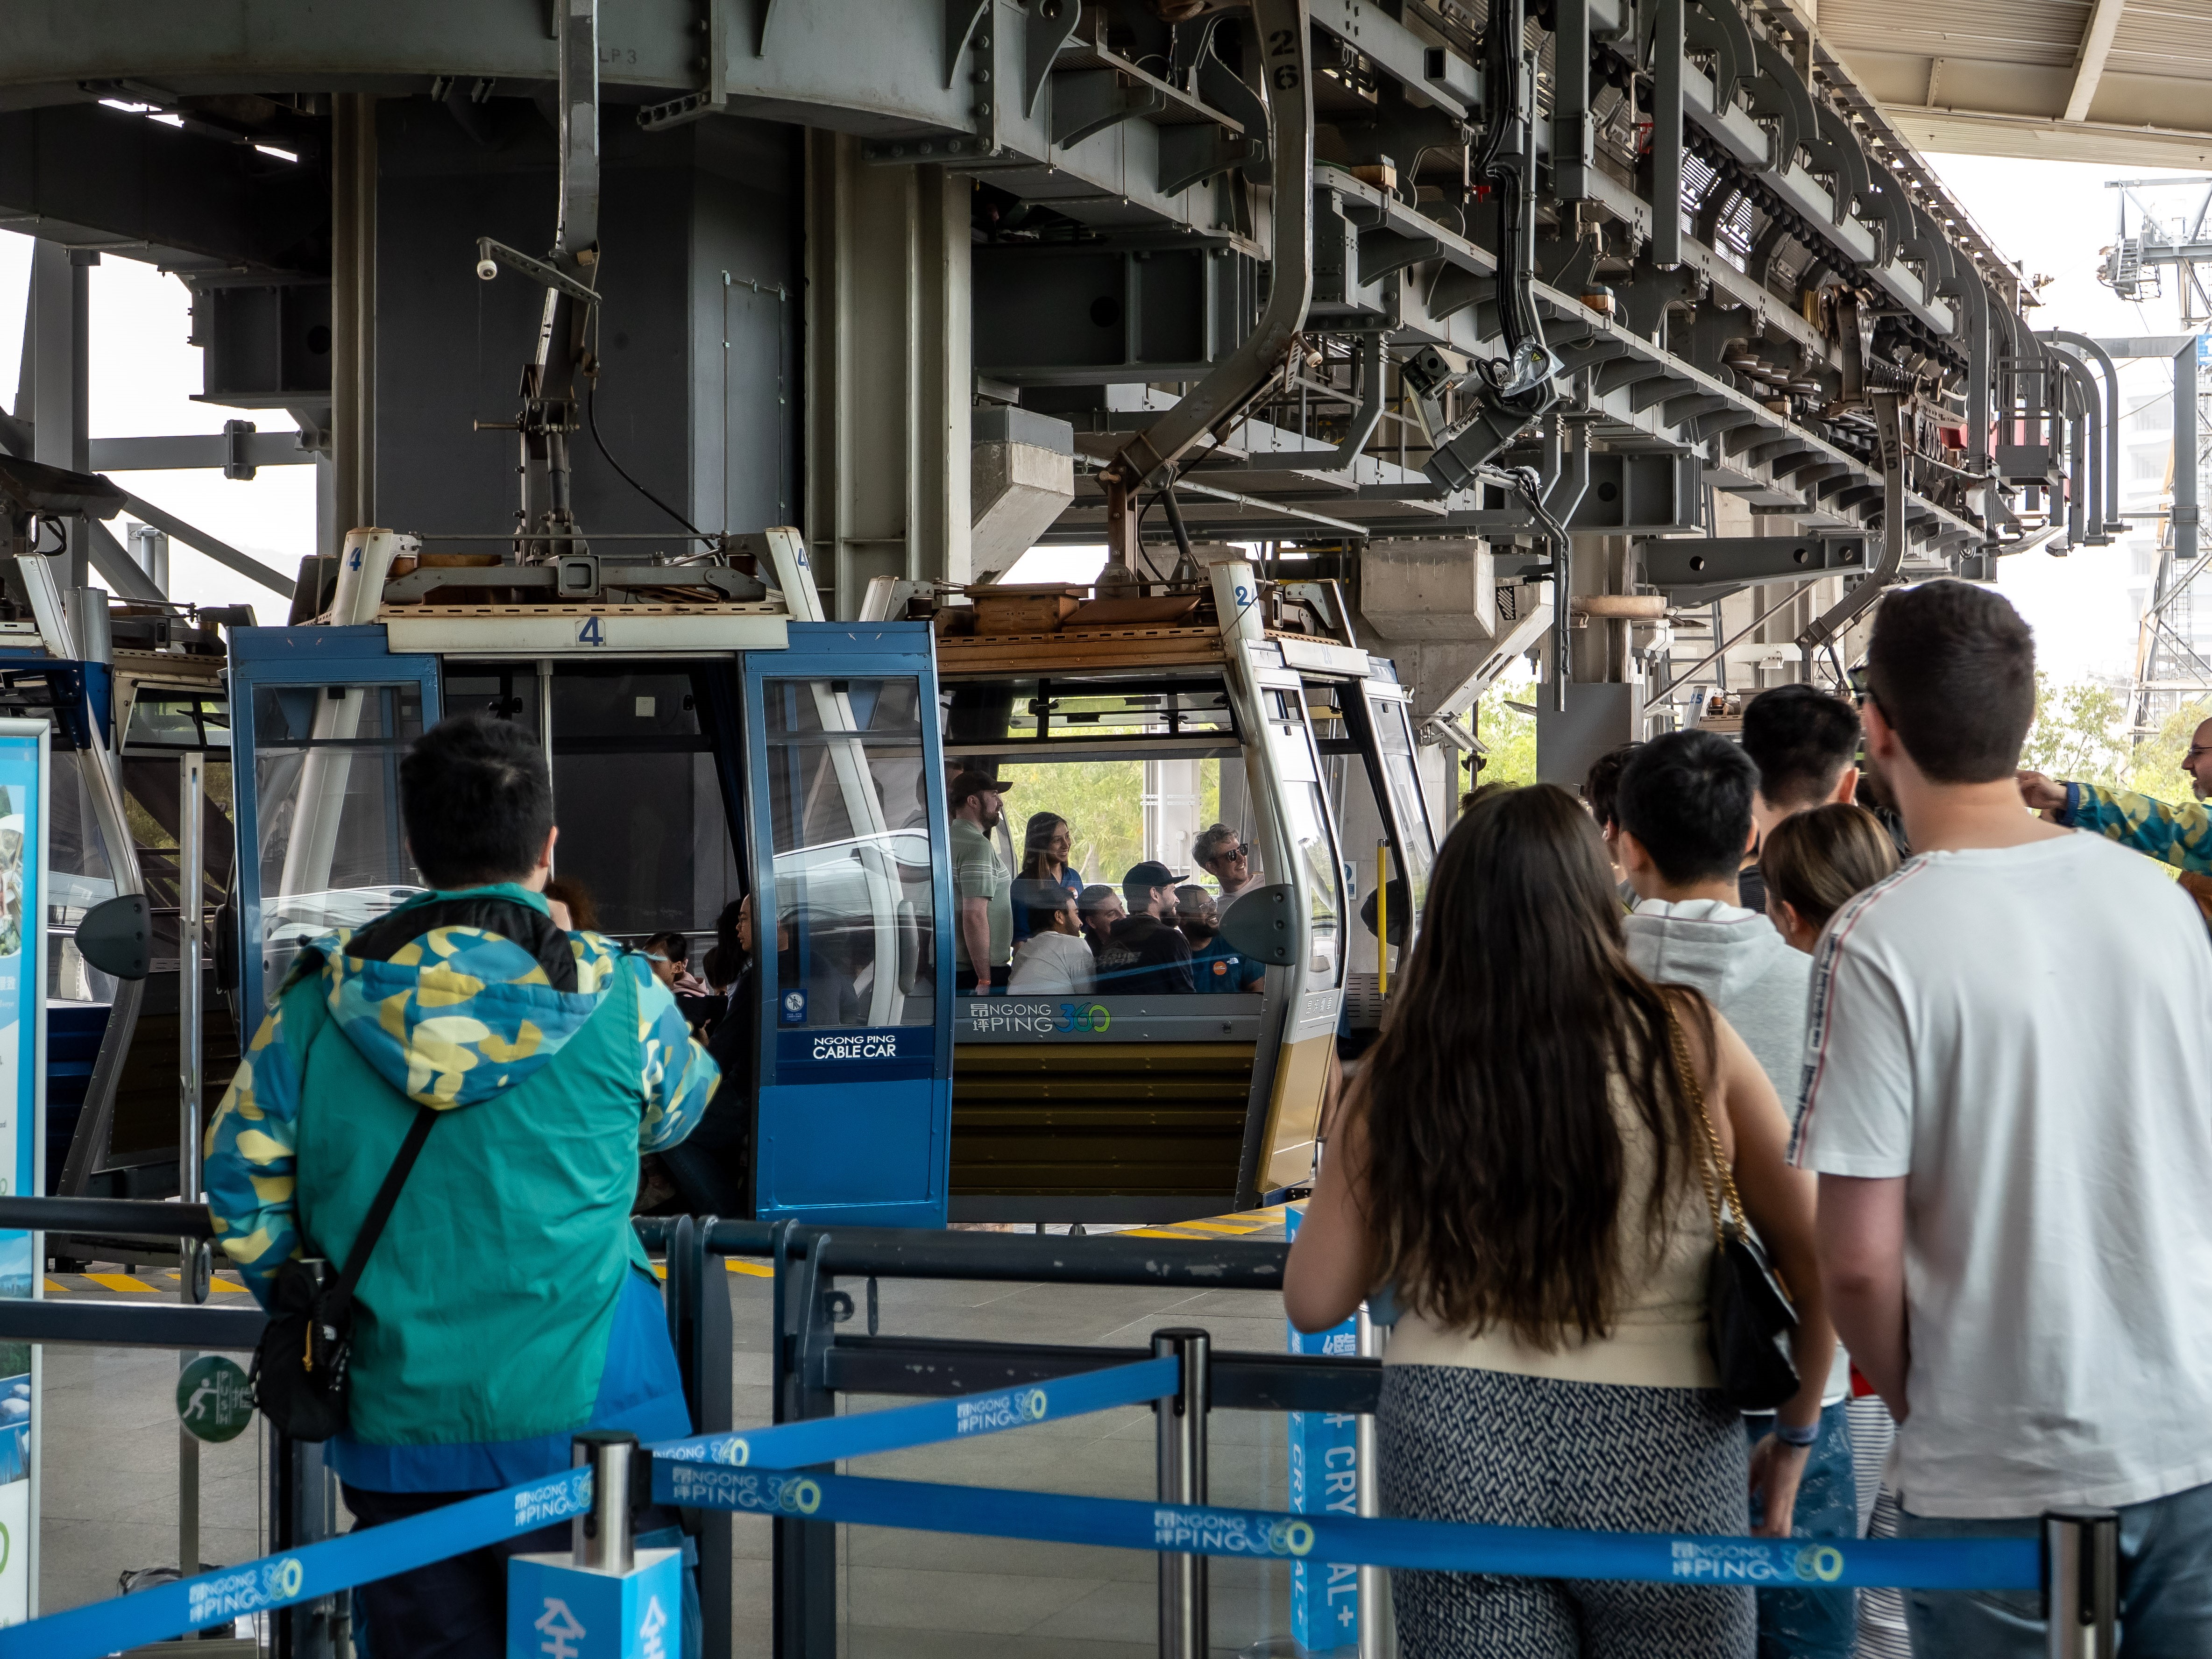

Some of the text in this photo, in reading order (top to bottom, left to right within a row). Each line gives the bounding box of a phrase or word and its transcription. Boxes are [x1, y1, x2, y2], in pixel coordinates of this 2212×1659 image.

[1269, 30, 1299, 90] 26
[1884, 421, 1898, 470] 125
[346, 547, 362, 571] 4
[798, 548, 809, 571] 4
[579, 616, 603, 647] 4
[989, 1004, 1051, 1016] NGONG
[991, 1002, 1111, 1033] PING 360
[813, 1044, 896, 1059] CABLE CAR
[814, 1035, 895, 1045] NGONG PING
[219, 1370, 230, 1425] PUSH
[969, 1396, 1010, 1414] NGONG
[969, 1389, 1046, 1432] PING 360
[527, 1481, 567, 1503] NGONG
[692, 1472, 758, 1488] NGONG
[692, 1476, 821, 1514] PING 360
[527, 1496, 568, 1524] PING
[1174, 1514, 1247, 1534] NGONG
[1175, 1516, 1314, 1555] PING 360
[1293, 1442, 1304, 1626] CRYAL+
[1324, 1445, 1357, 1628] CRYAL+
[1692, 1543, 1771, 1560] NGONG
[1694, 1543, 1843, 1582] PING 360
[204, 1557, 303, 1619] PING 360
[207, 1569, 257, 1595] NGONG
